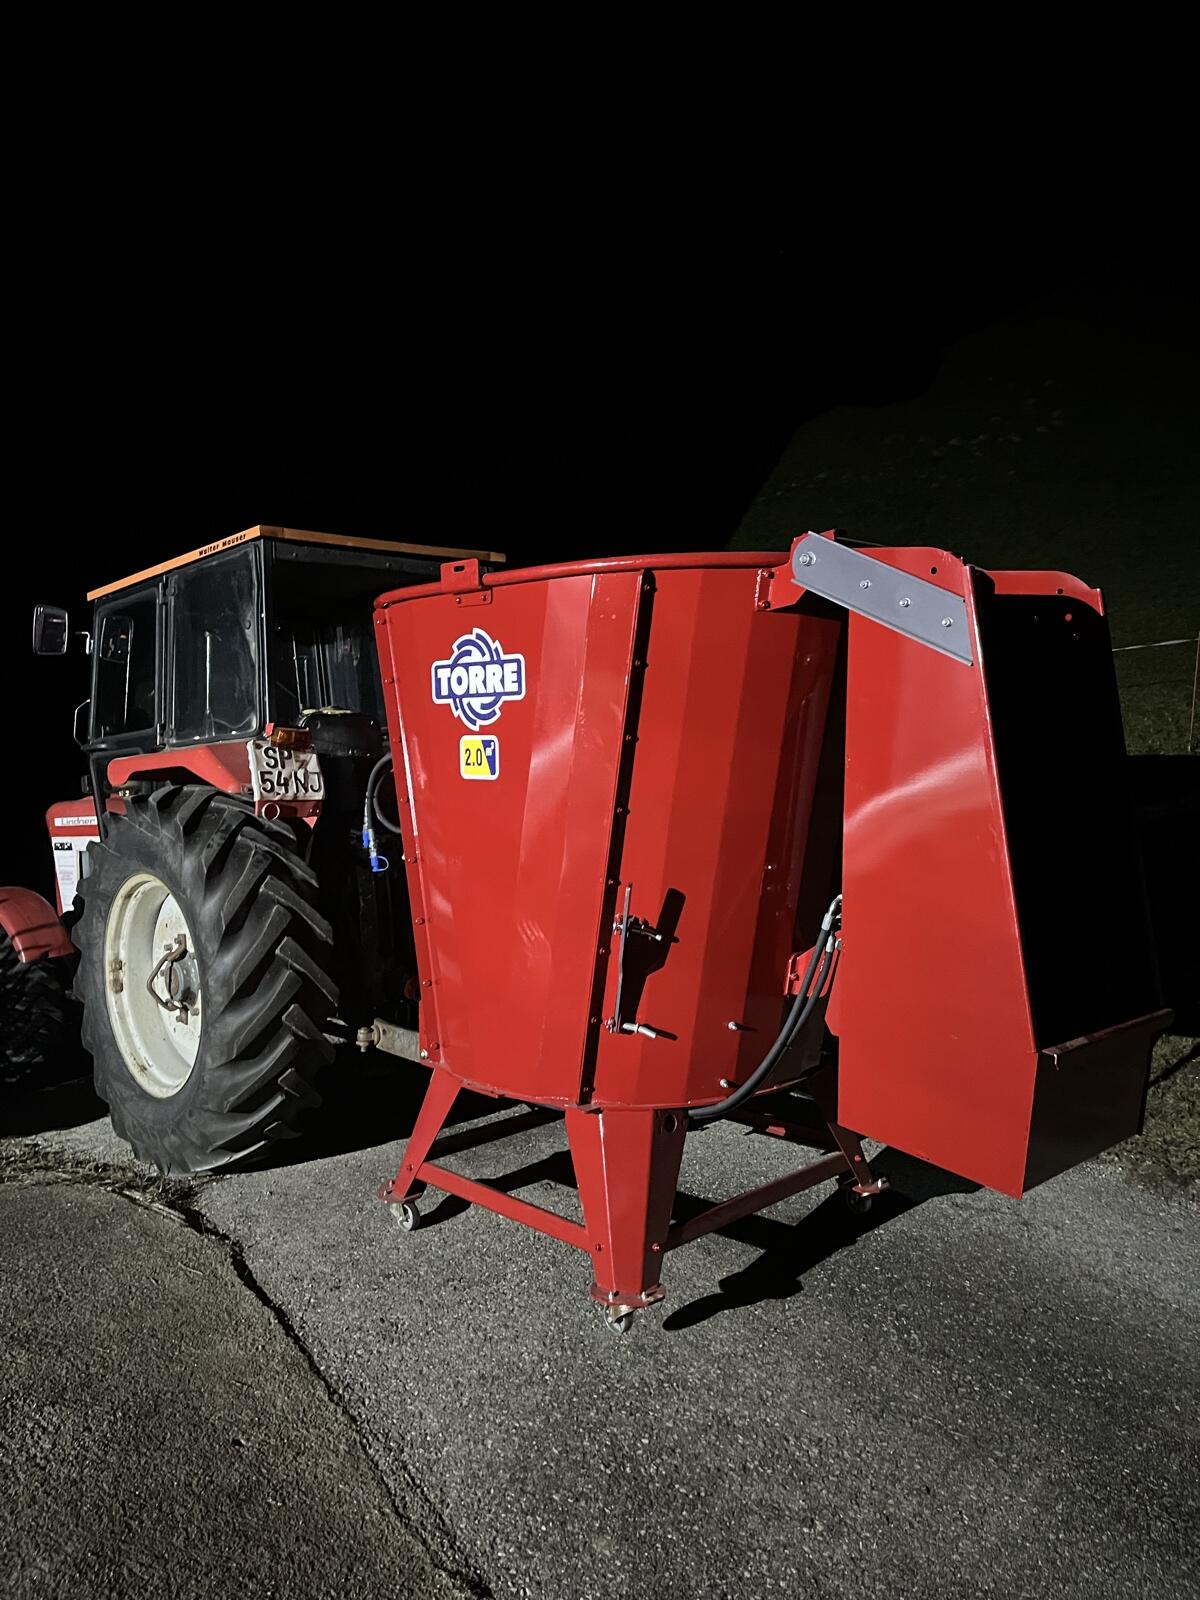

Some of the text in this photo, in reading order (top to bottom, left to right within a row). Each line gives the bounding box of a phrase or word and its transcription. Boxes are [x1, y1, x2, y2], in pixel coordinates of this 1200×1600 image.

[437, 662, 519, 696] TORRE
[263, 746, 292, 769] SP
[464, 748, 483, 767] 2.0
